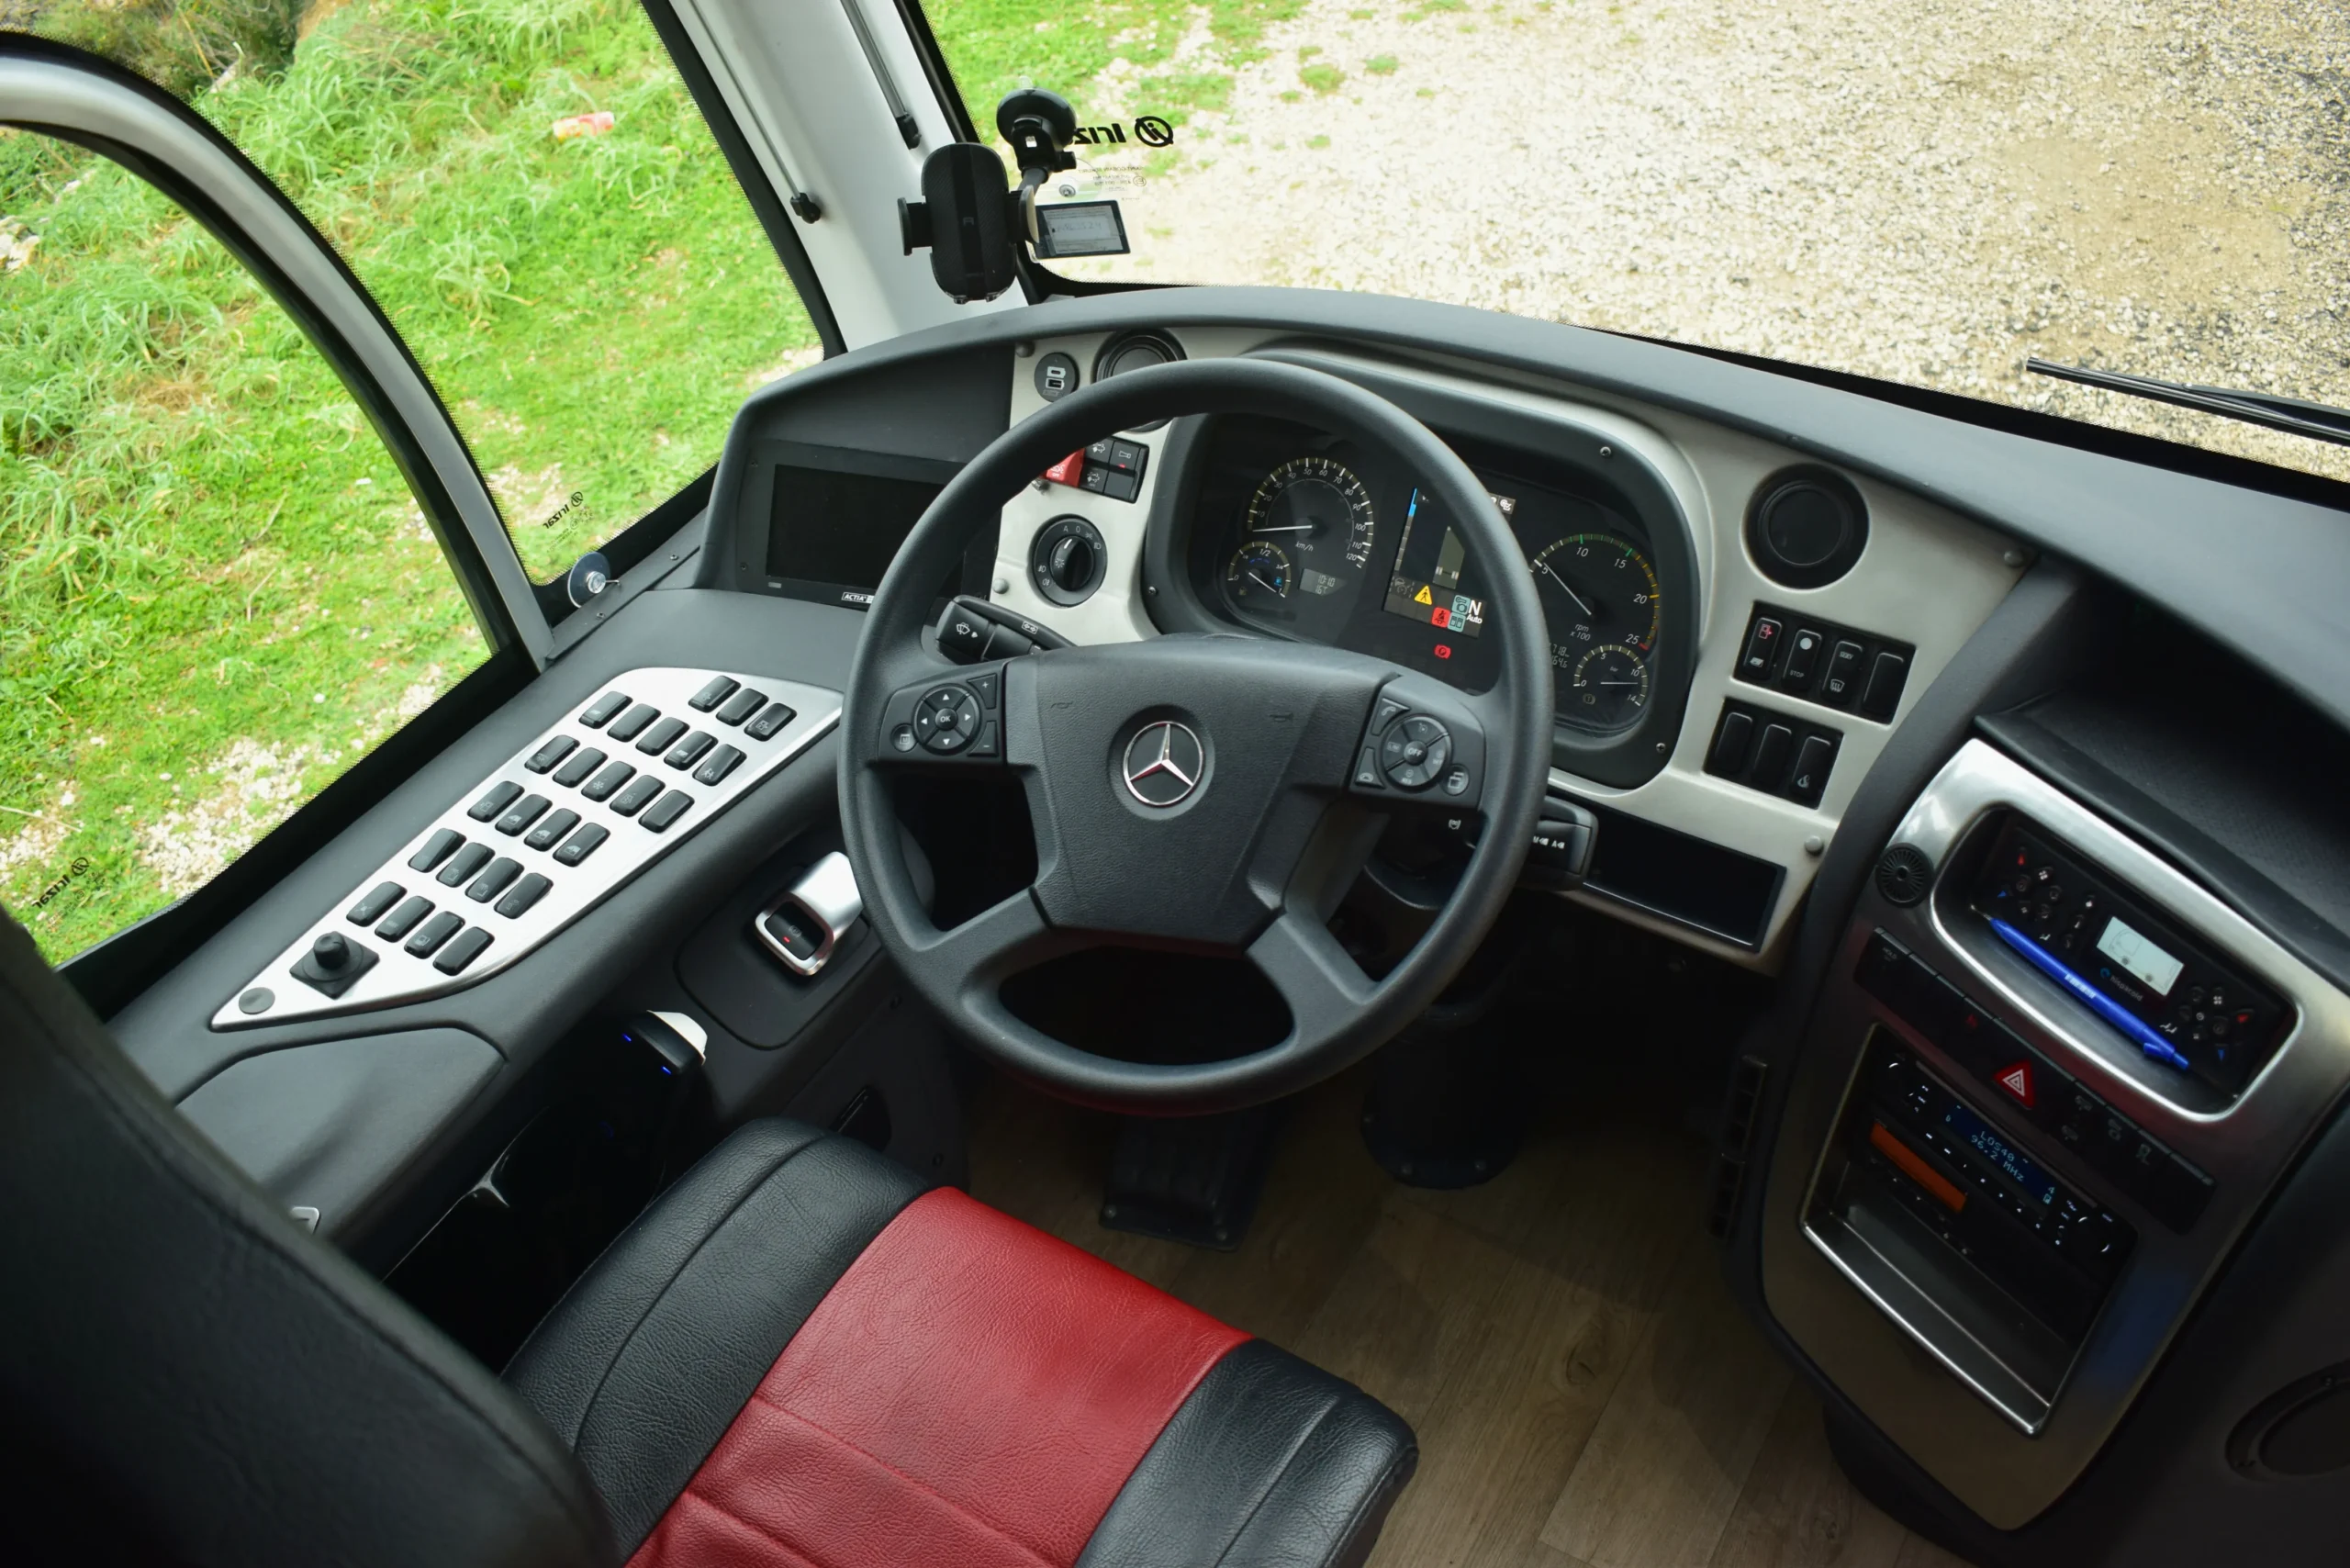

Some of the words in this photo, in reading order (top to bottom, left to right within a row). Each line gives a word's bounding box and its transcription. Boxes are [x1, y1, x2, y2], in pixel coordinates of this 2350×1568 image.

[1274, 479, 1283, 488] 30
[1333, 476, 1343, 485] 70
[1264, 493, 1272, 501] 20
[1352, 503, 1361, 511] 90
[1355, 523, 1366, 532] 100
[1295, 541, 1314, 552] km/h
[1352, 541, 1363, 549] 110
[1259, 549, 1271, 557] 1/2
[1576, 546, 1589, 557] 10
[1346, 553, 1359, 561] 120
[1614, 558, 1627, 568] 15
[1633, 594, 1648, 604] 20
[1469, 599, 1482, 616] N
[1467, 614, 1483, 624] Auto
[1575, 623, 1589, 633] rpm
[1576, 632, 1591, 641] 100
[1626, 633, 1639, 644] 25
[1790, 669, 1805, 678] STOP
[1627, 694, 1637, 702] 14
[940, 715, 951, 723] OK
[1407, 746, 1423, 757] OFF
[1980, 1130, 2015, 1161] LOS40
[1971, 1134, 1998, 1160] 96.2
[2003, 1160, 2025, 1182] MHz
